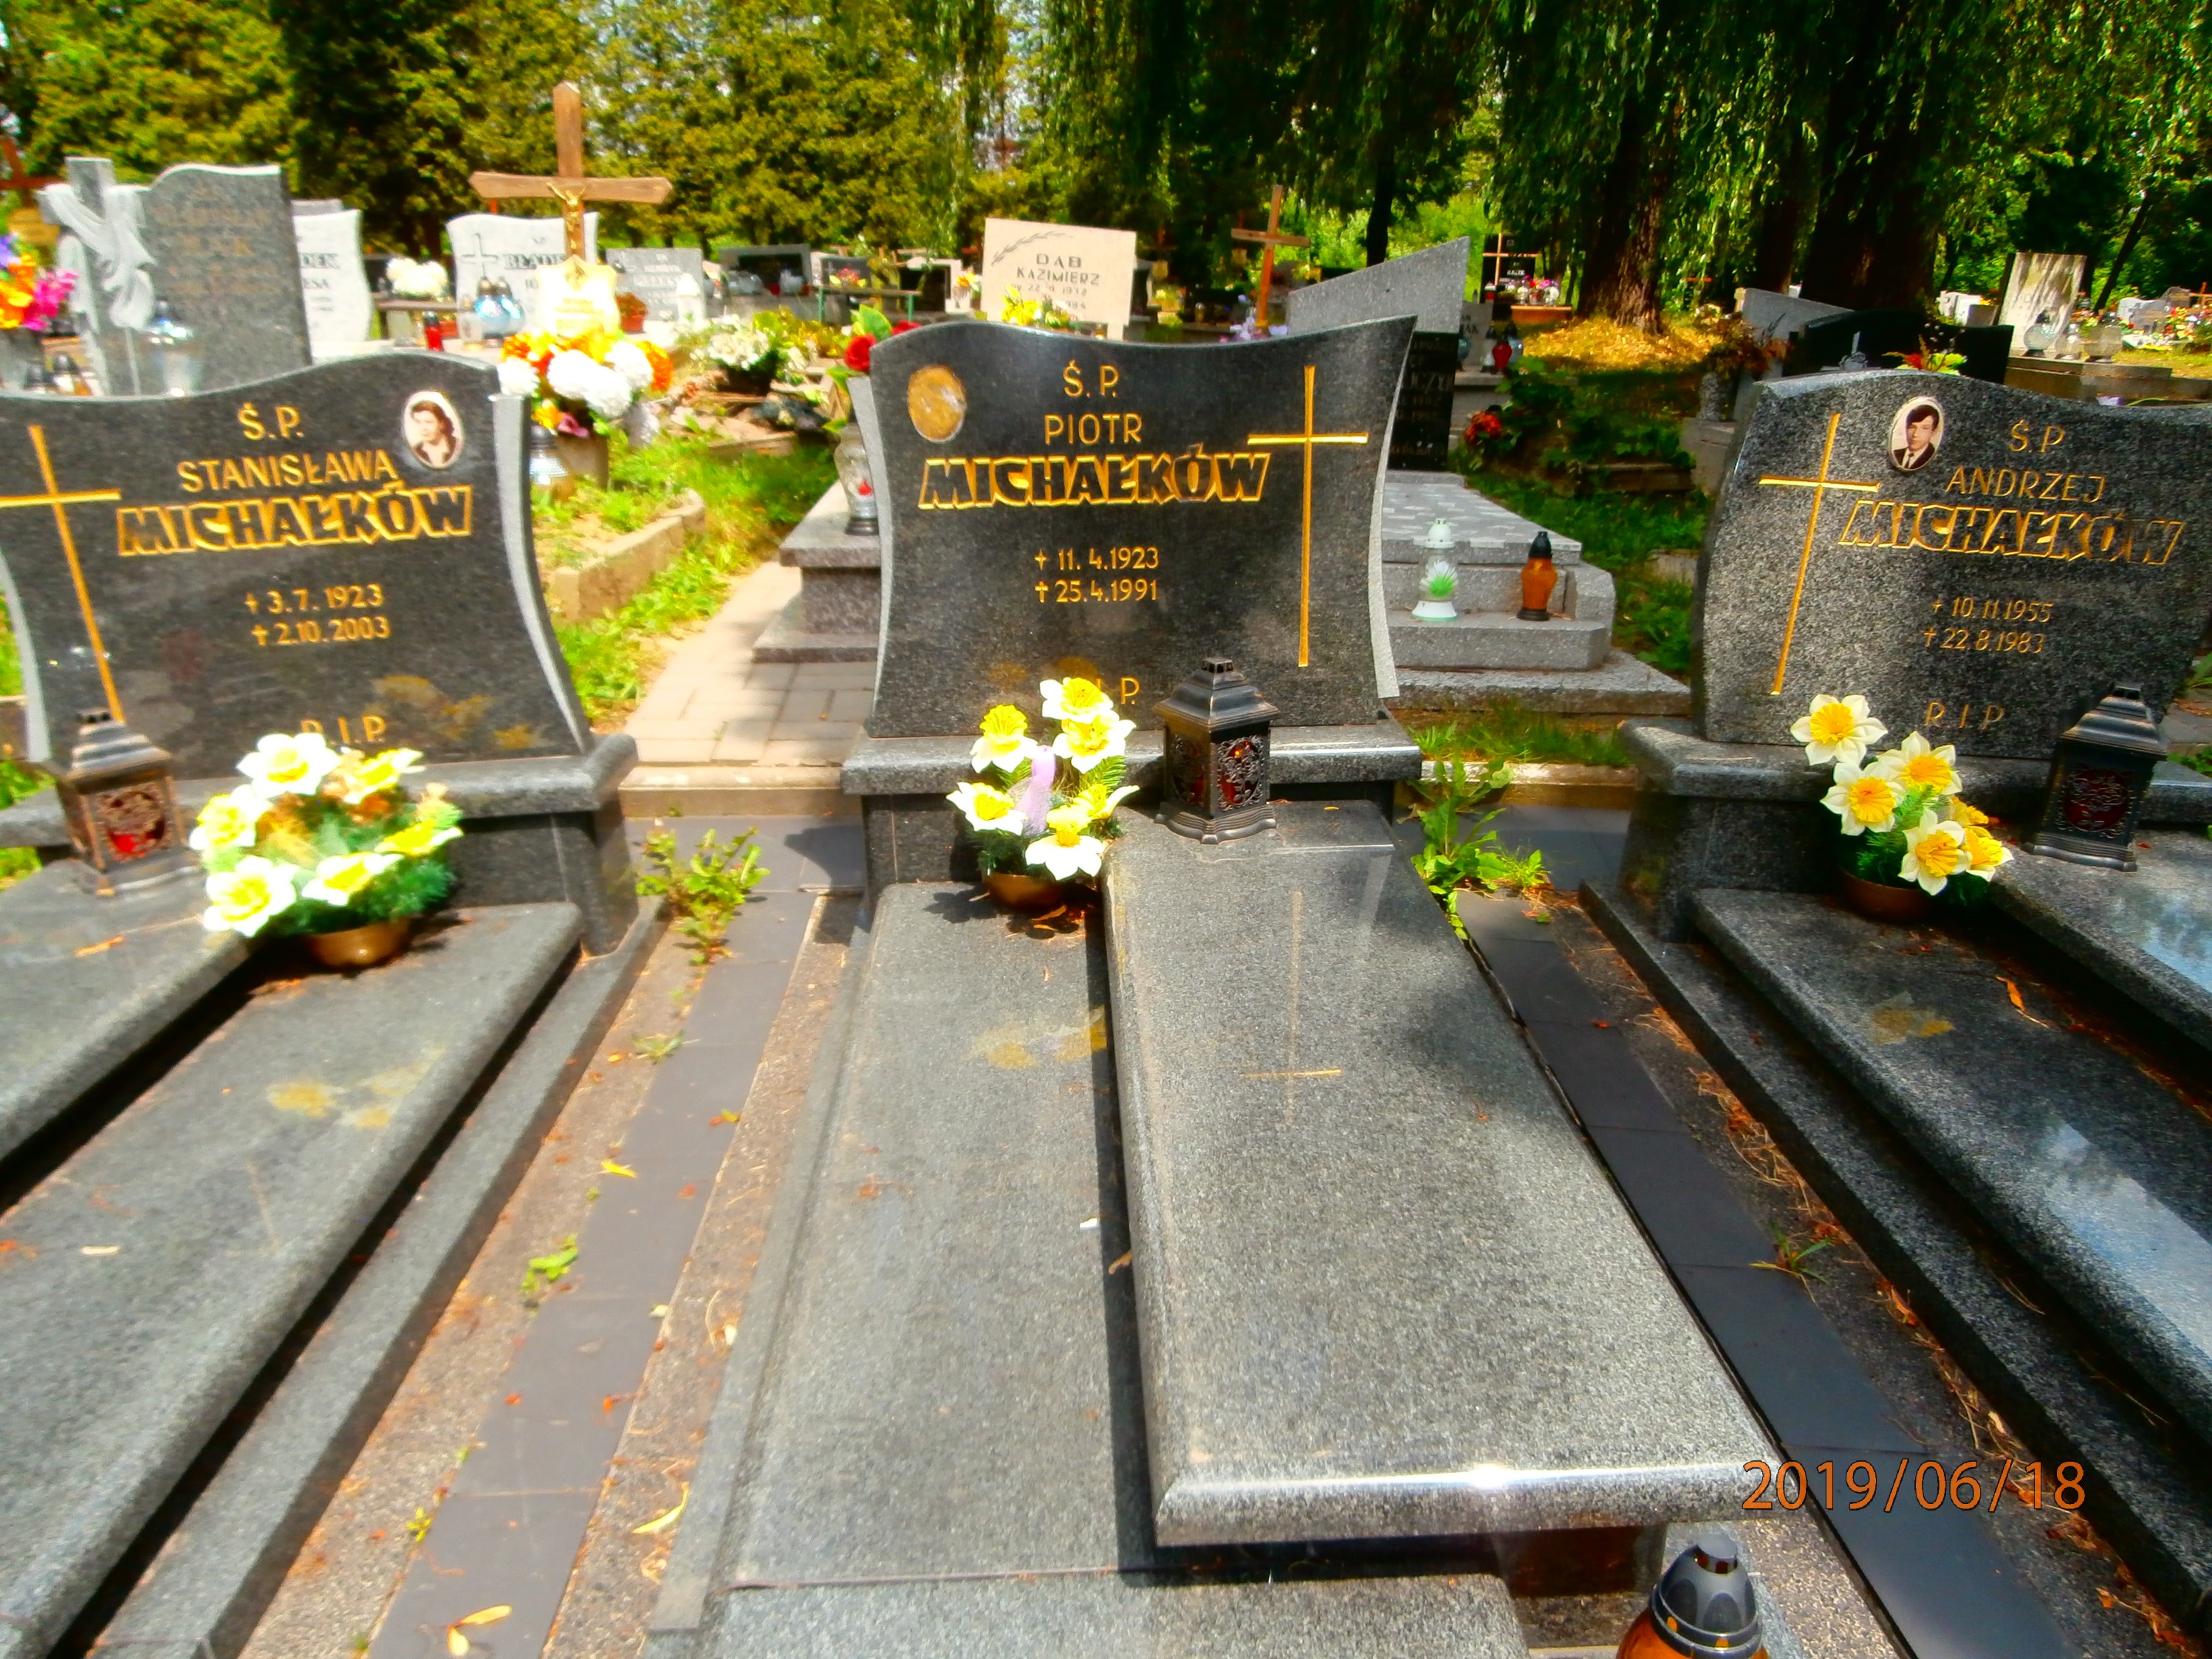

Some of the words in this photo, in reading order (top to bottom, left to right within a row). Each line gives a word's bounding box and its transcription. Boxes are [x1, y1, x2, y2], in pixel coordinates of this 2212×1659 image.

[1016, 266, 1100, 287] KAZIMIERZ
[1044, 412, 1143, 445] PIOTR
[177, 449, 400, 493] STANISŁAWA
[917, 442, 1271, 510] MICHAŁKÓW
[1944, 465, 2107, 504] ANDRZEJ
[115, 480, 473, 557] MICHAŁKÓW
[1837, 499, 2185, 566] MICHAŁKÓW
[1054, 578, 1158, 603] 25.4.1991
